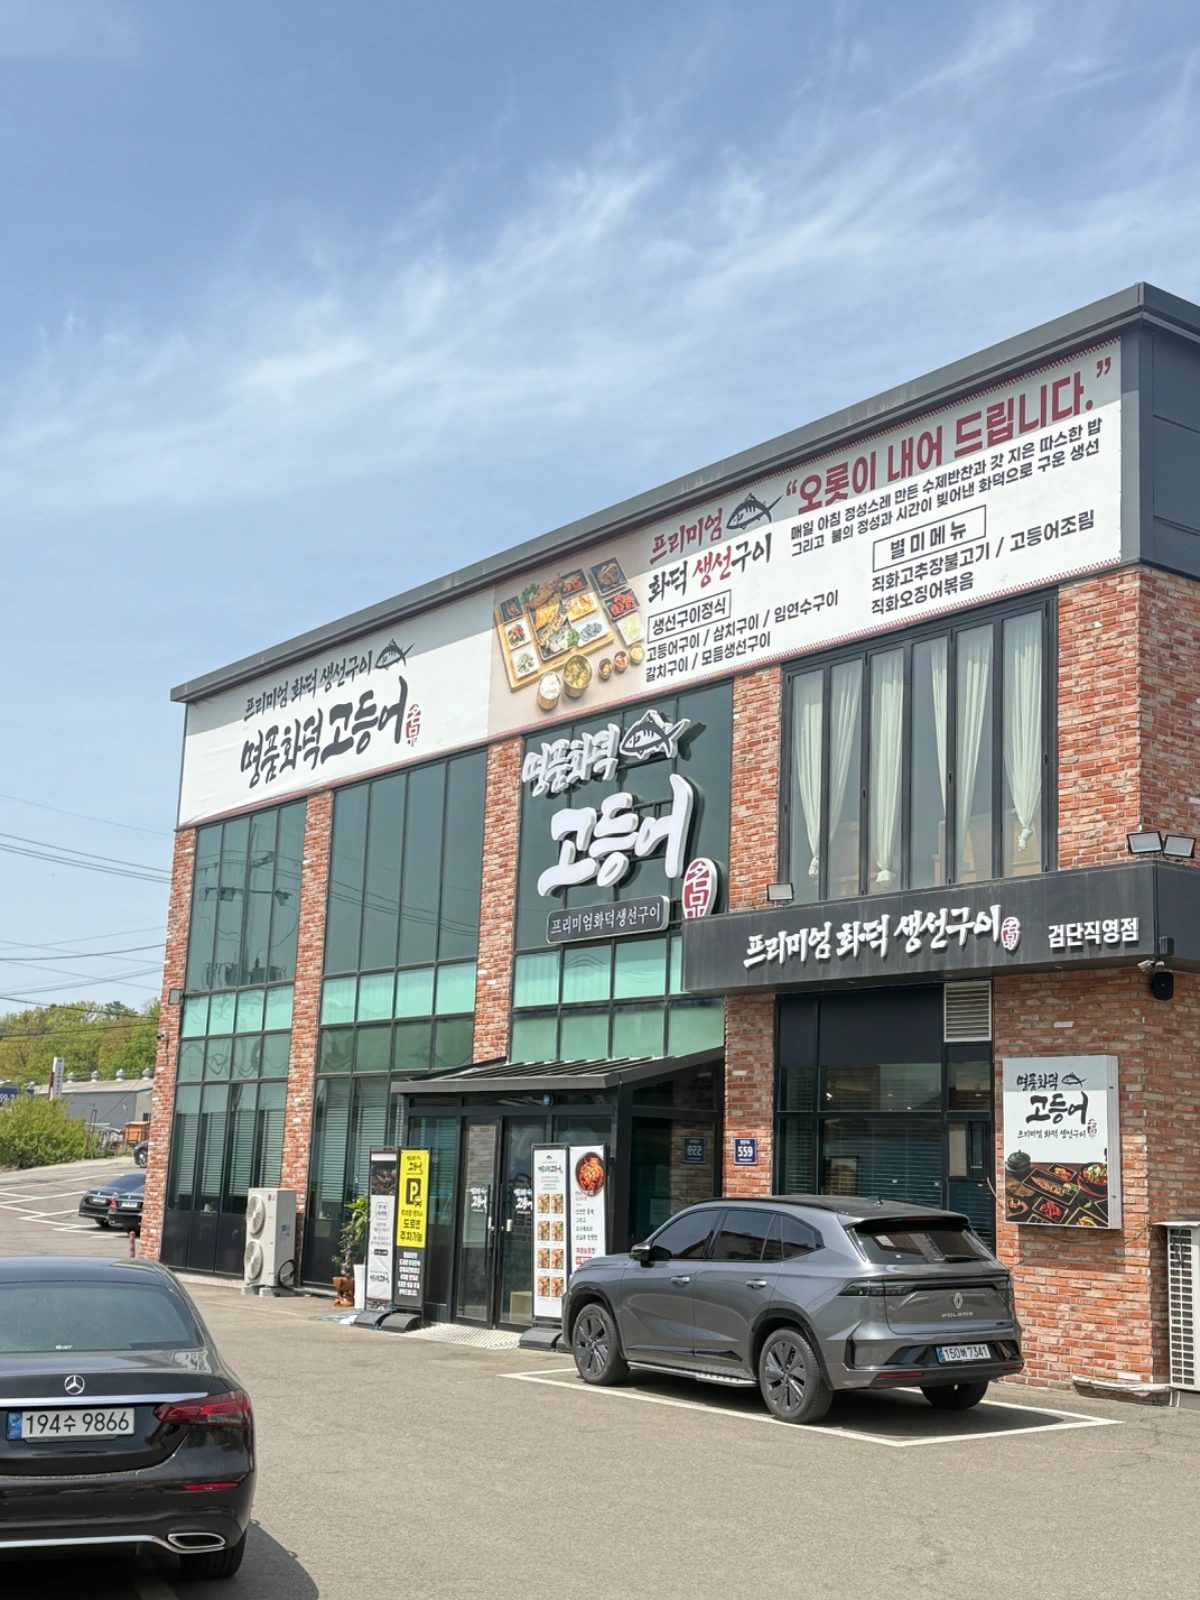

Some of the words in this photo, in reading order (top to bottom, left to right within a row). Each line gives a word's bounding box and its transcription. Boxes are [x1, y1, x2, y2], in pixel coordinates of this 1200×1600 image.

[791, 520, 814, 541] 매일
[817, 511, 841, 531] 아침
[845, 494, 891, 522] 정성스레
[894, 483, 919, 504] 만든
[922, 459, 987, 494] 수제반찬과
[990, 453, 1005, 471] 갓
[1008, 442, 1035, 464] 지은
[1040, 425, 1083, 451] 따스한
[1087, 417, 1103, 436] 밥
[888, 425, 943, 483] 내어
[791, 534, 825, 557] 그리고
[831, 524, 854, 544] 불의
[857, 512, 893, 535] 정성과
[896, 496, 932, 522] 시간이
[937, 482, 975, 508] 빚어낸
[978, 462, 1033, 494] 화덕으로
[1037, 452, 1066, 473] 구운
[1070, 438, 1100, 461] 생선
[649, 508, 723, 565] 프리미엄
[871, 541, 990, 592] 직화고추장불고기
[1010, 509, 1095, 552] 고등어조림
[648, 560, 688, 603] 화덕
[692, 533, 772, 588] 생선구이
[871, 571, 975, 615] 직화오징어볶음
[646, 632, 700, 663] 고등어구이
[713, 613, 759, 643] 삼치구이
[774, 589, 839, 624] 임연수구이
[652, 597, 726, 636] 생선구이정식
[244, 681, 289, 721] 프리미엄
[291, 669, 317, 702] 화덕
[320, 650, 373, 692] 생선구이
[645, 657, 688, 683] 갈치구이
[701, 631, 771, 666] 모듬생선구이
[320, 675, 408, 764] 고등어
[522, 723, 621, 797] 명품화덕
[537, 773, 694, 897] 고등어
[743, 921, 832, 968] 프리미엄
[836, 913, 888, 958] 화덕
[893, 904, 1002, 951] 생선구이
[1048, 917, 1140, 948] 검단직영점
[1016, 1073, 1059, 1091] 명품화덕
[1026, 1091, 1089, 1125] 고등어
[737, 1146, 753, 1157] 559
[26, 1413, 77, 1435] 194수
[82, 1411, 130, 1433] 9866
